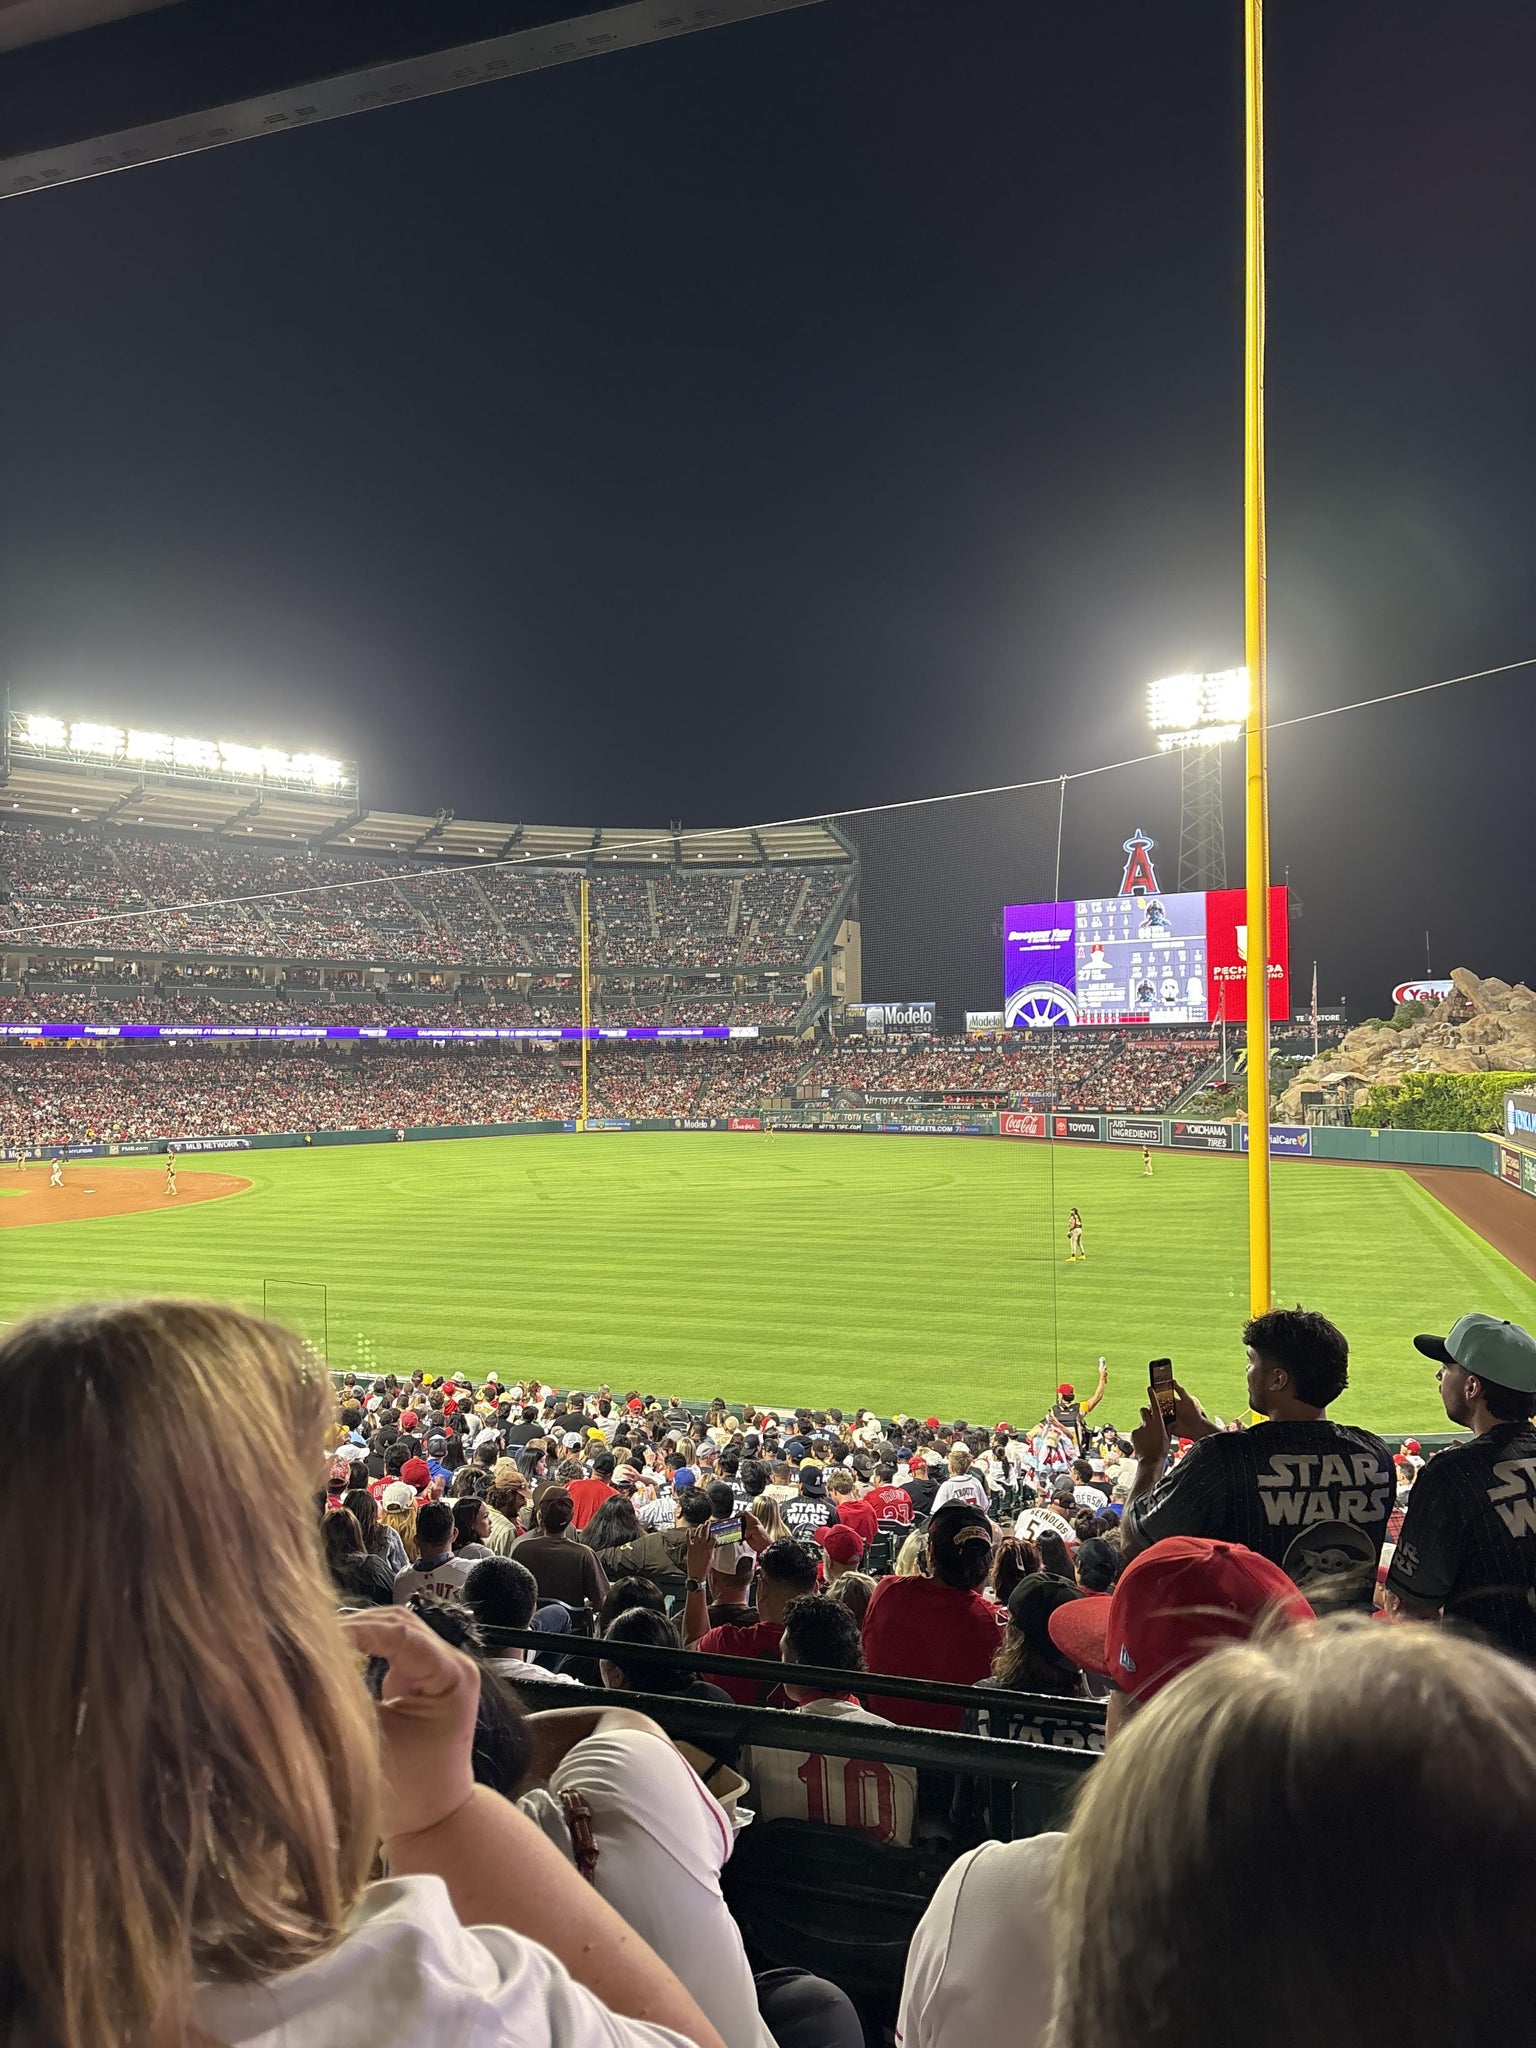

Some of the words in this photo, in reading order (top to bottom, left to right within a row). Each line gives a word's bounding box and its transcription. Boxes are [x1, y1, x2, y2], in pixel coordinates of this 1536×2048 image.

[1213, 964, 1283, 975] PECHGA
[1408, 989, 1447, 1001] Yaku
[884, 1006, 932, 1025] Modelo
[972, 1015, 1000, 1027] Modelo
[683, 1119, 708, 1129] Modelo
[1068, 1122, 1096, 1133] TOYOTA
[1111, 1120, 1127, 1128] JUST
[1112, 1128, 1158, 1141] INGREDIENTS
[203, 1141, 239, 1150] NETWORK
[1207, 1138, 1227, 1148] TIRES
[1257, 1452, 1390, 1489] STAR
[954, 1487, 975, 1498] TROUT
[786, 1502, 830, 1516] STAR
[1259, 1487, 1390, 1526] WARS
[787, 1513, 830, 1526] WARS
[883, 1504, 910, 1524] 27
[797, 1752, 897, 1845] 10
